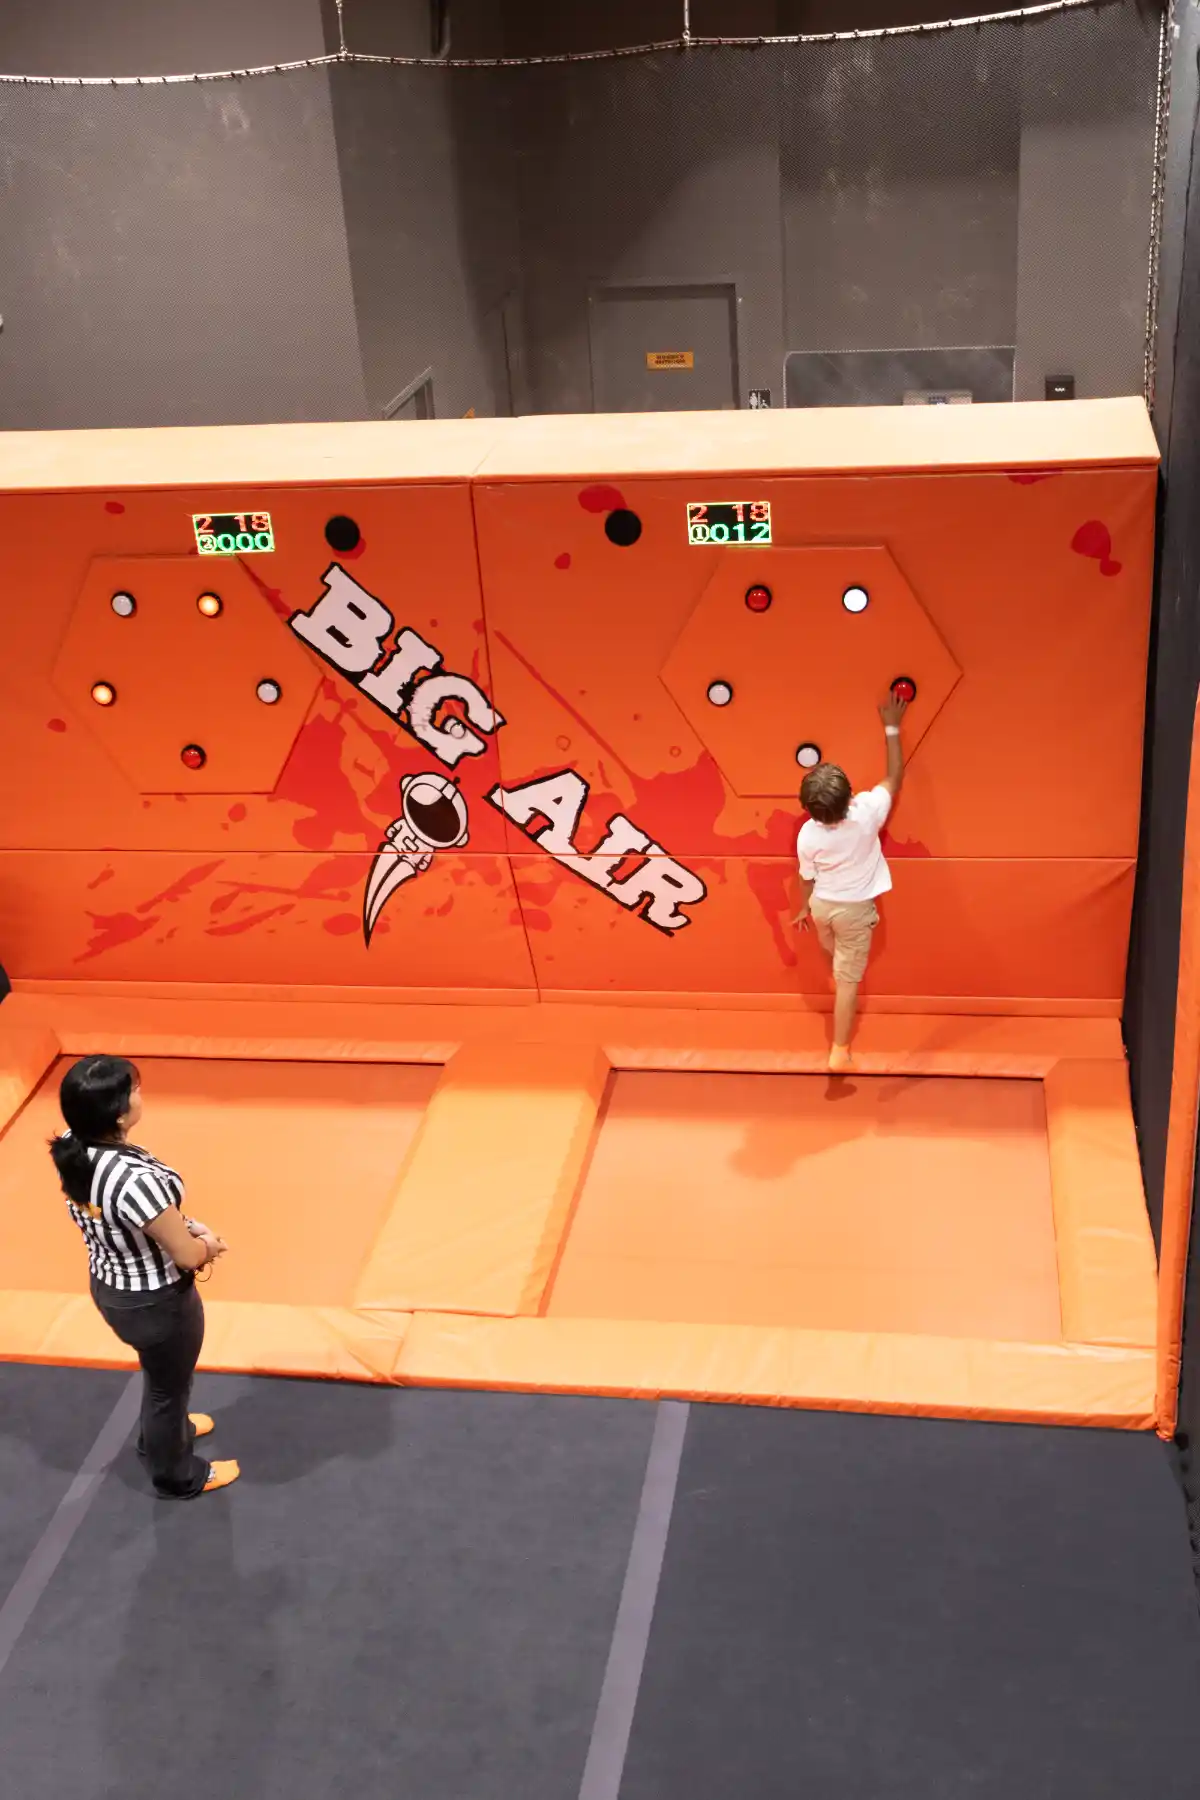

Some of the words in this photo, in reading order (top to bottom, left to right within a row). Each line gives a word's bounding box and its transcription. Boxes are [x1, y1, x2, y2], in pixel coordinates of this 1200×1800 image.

[196, 515, 214, 533] 2
[234, 513, 269, 532] 18
[689, 504, 709, 523] 2
[731, 502, 769, 522] 18
[287, 562, 507, 770] BIG
[483, 768, 708, 938] AIR
